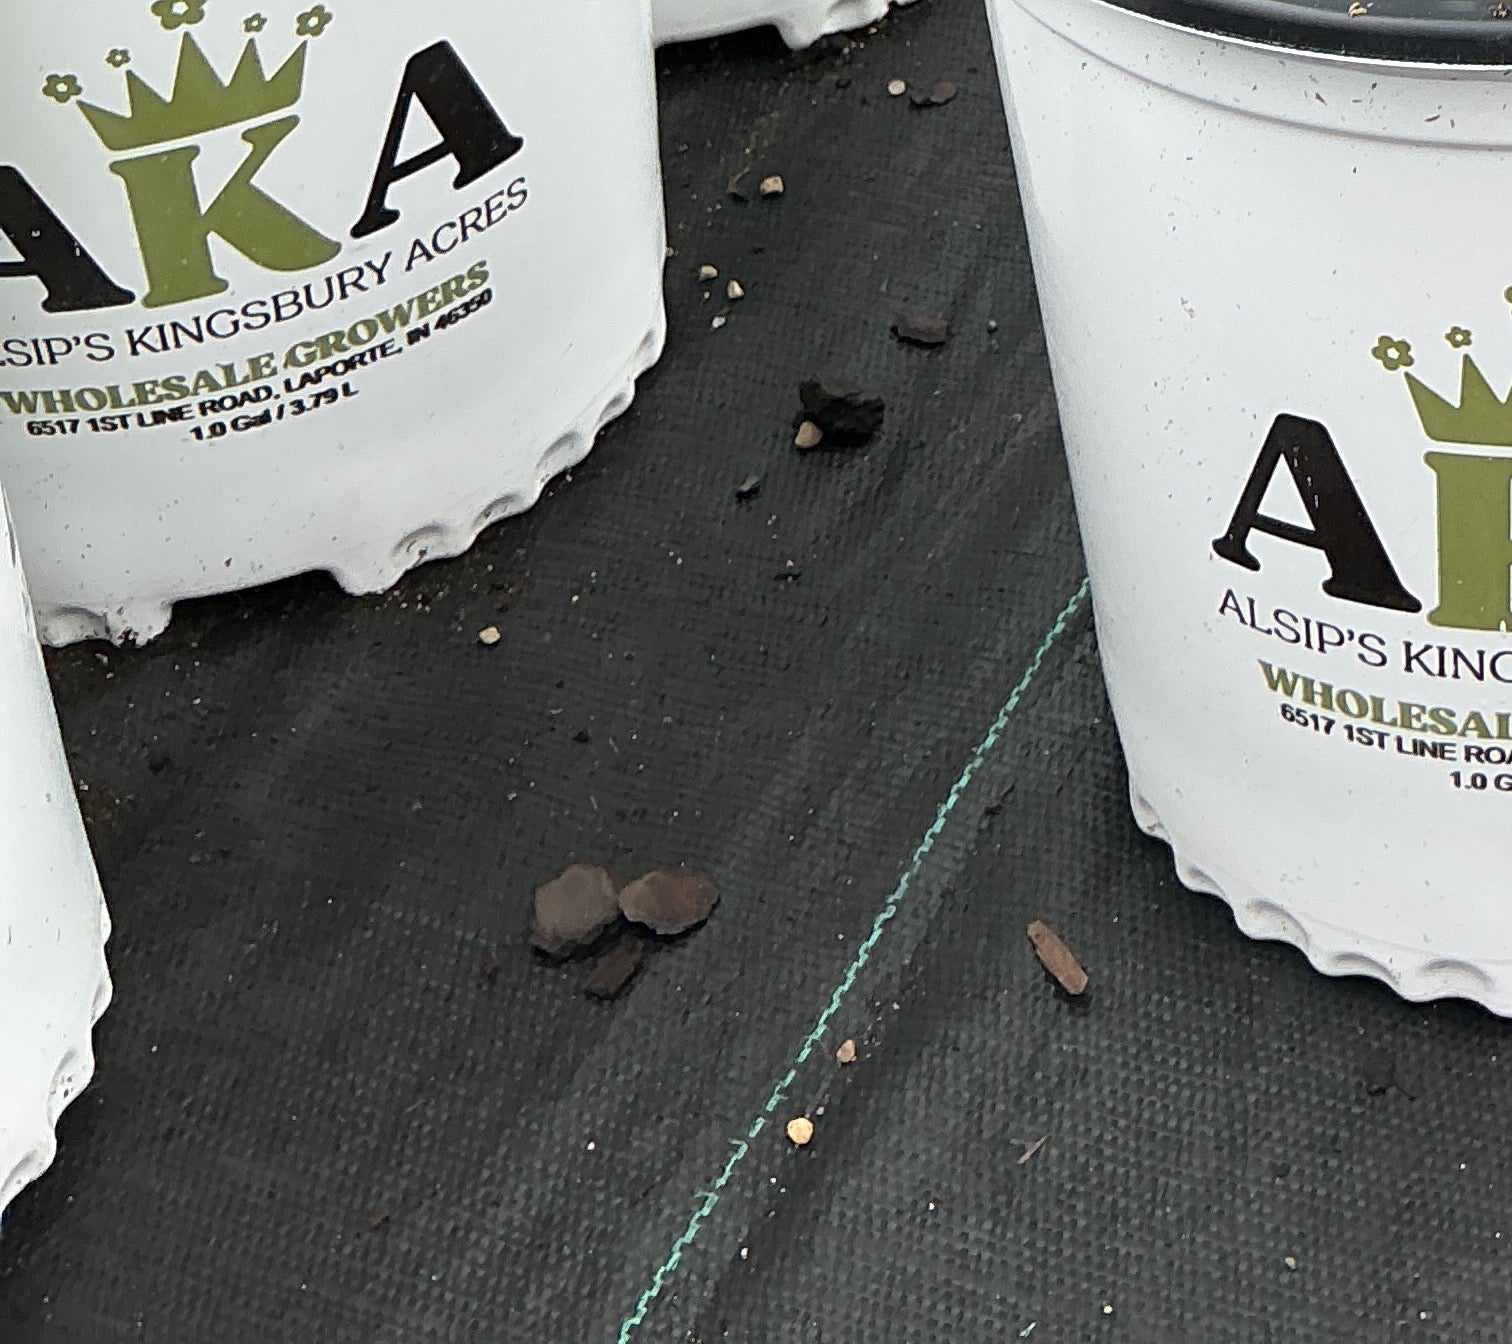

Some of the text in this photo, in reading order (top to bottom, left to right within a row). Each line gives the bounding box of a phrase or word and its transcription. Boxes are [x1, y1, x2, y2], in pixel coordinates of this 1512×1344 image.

[0, 177, 528, 367] SIP'S KINGSBURY ACRES
[0, 260, 490, 414] WHOLESALE GROWERS
[27, 419, 79, 436] 6517
[86, 413, 131, 432] 1ST
[137, 403, 195, 427] LINE
[406, 321, 430, 345] IN
[434, 288, 492, 330] 46350
[190, 381, 359, 441] 1.0 Gal / 3.79 L
[1218, 588, 1387, 667] ALSIP'S
[1280, 702, 1336, 736] 6517
[1343, 723, 1390, 750] 1ST
[1396, 734, 1458, 761] LINE
[1450, 770, 1488, 790] 1.0
